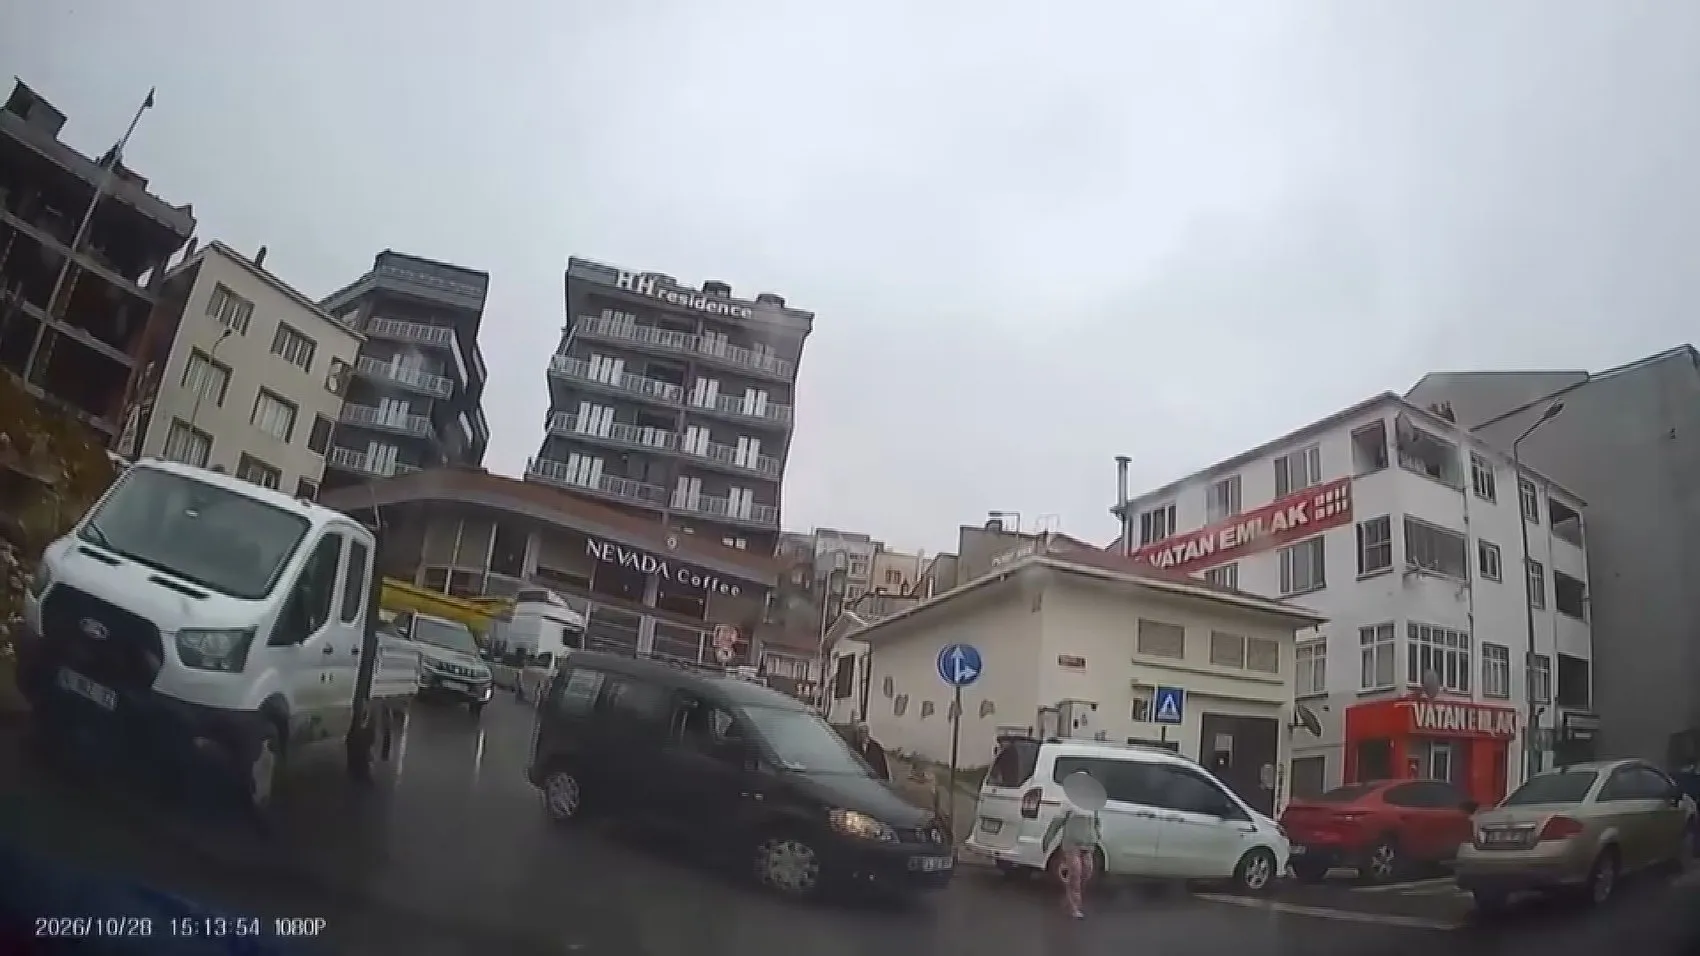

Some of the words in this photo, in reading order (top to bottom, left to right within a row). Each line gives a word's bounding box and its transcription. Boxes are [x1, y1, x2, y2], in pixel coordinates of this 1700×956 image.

[658, 288, 752, 320] residence
[1150, 533, 1214, 568] VATAN
[1219, 501, 1308, 550] EMLAK
[586, 538, 671, 581] NEVADA
[677, 568, 741, 597] Coffee
[1414, 703, 1465, 730] VATAN
